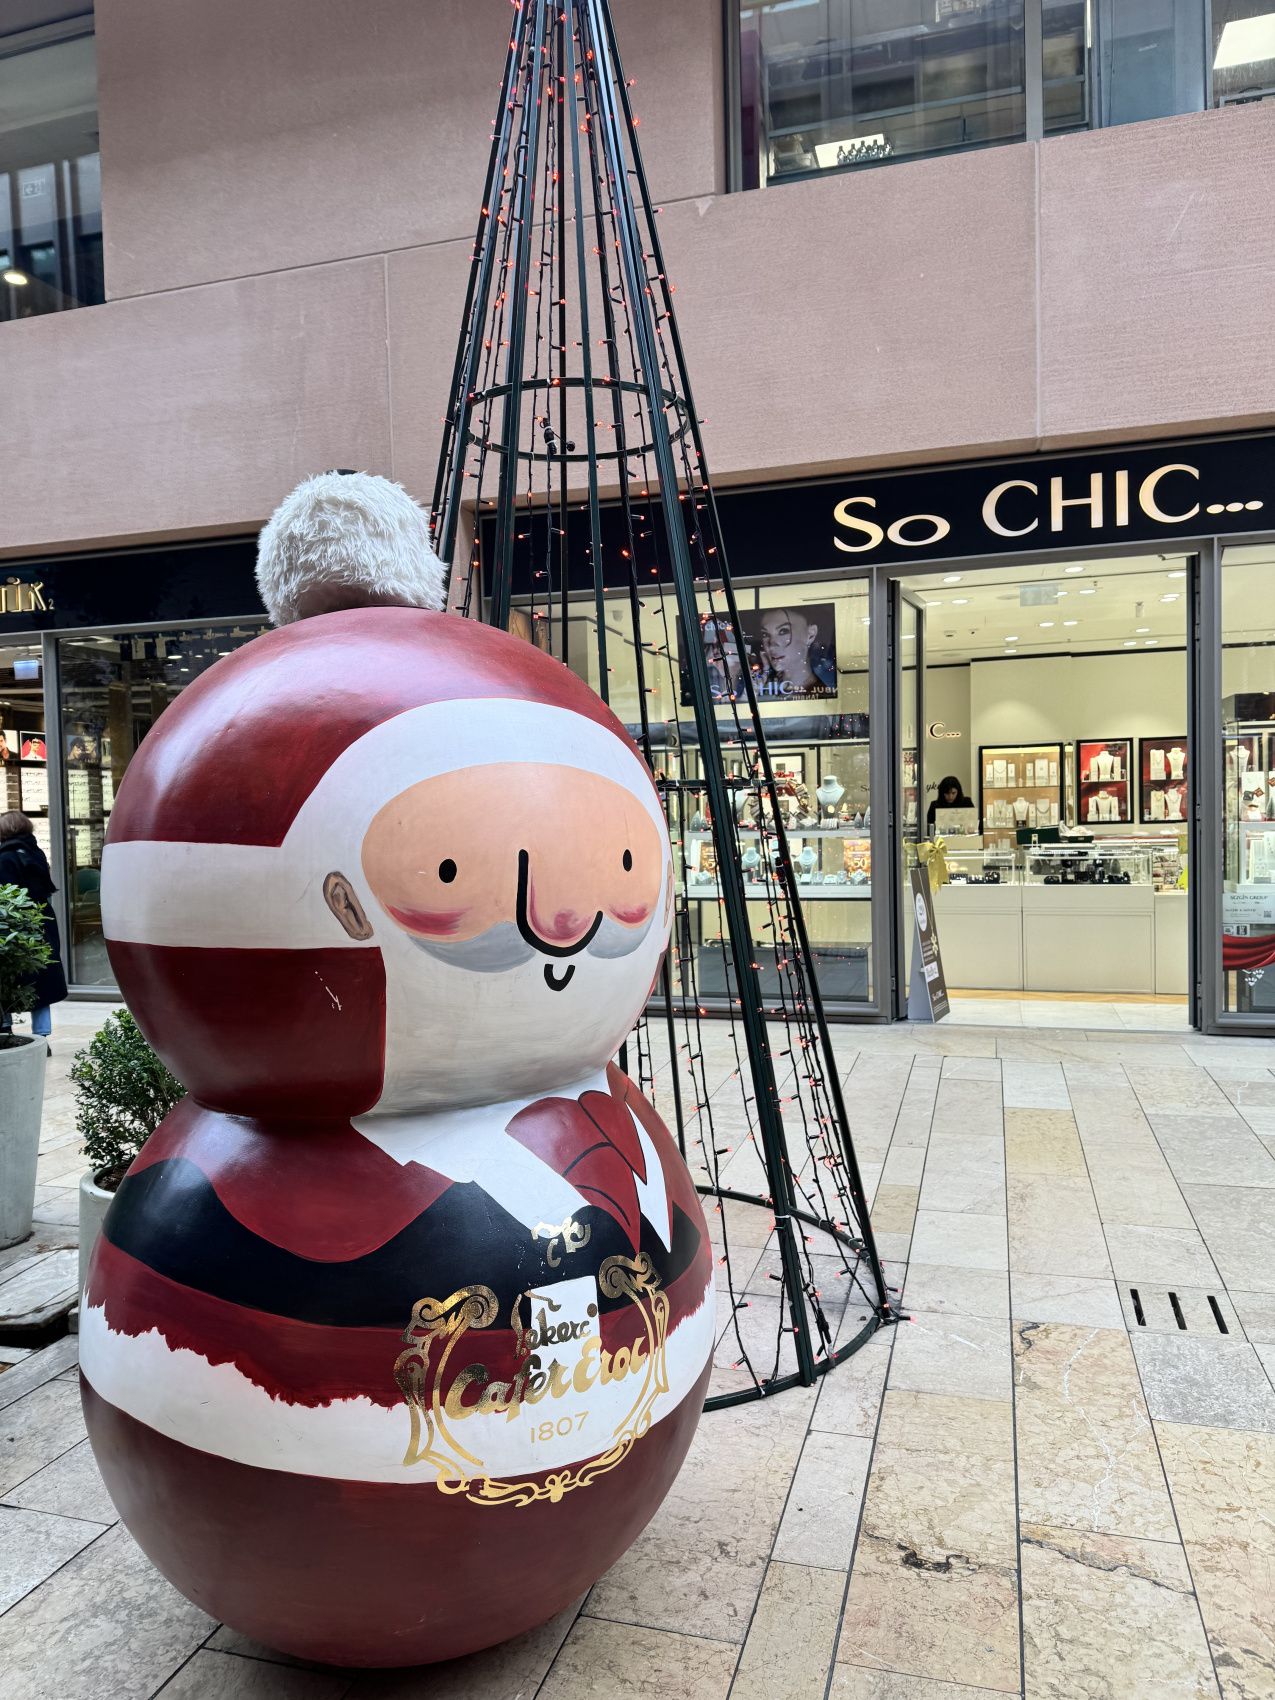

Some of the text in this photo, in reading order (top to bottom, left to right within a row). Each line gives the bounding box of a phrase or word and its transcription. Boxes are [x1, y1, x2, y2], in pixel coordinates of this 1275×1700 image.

[833, 496, 951, 553] So
[444, 1336, 648, 1422] Cafer Erol
[530, 1411, 590, 1443] 1807
